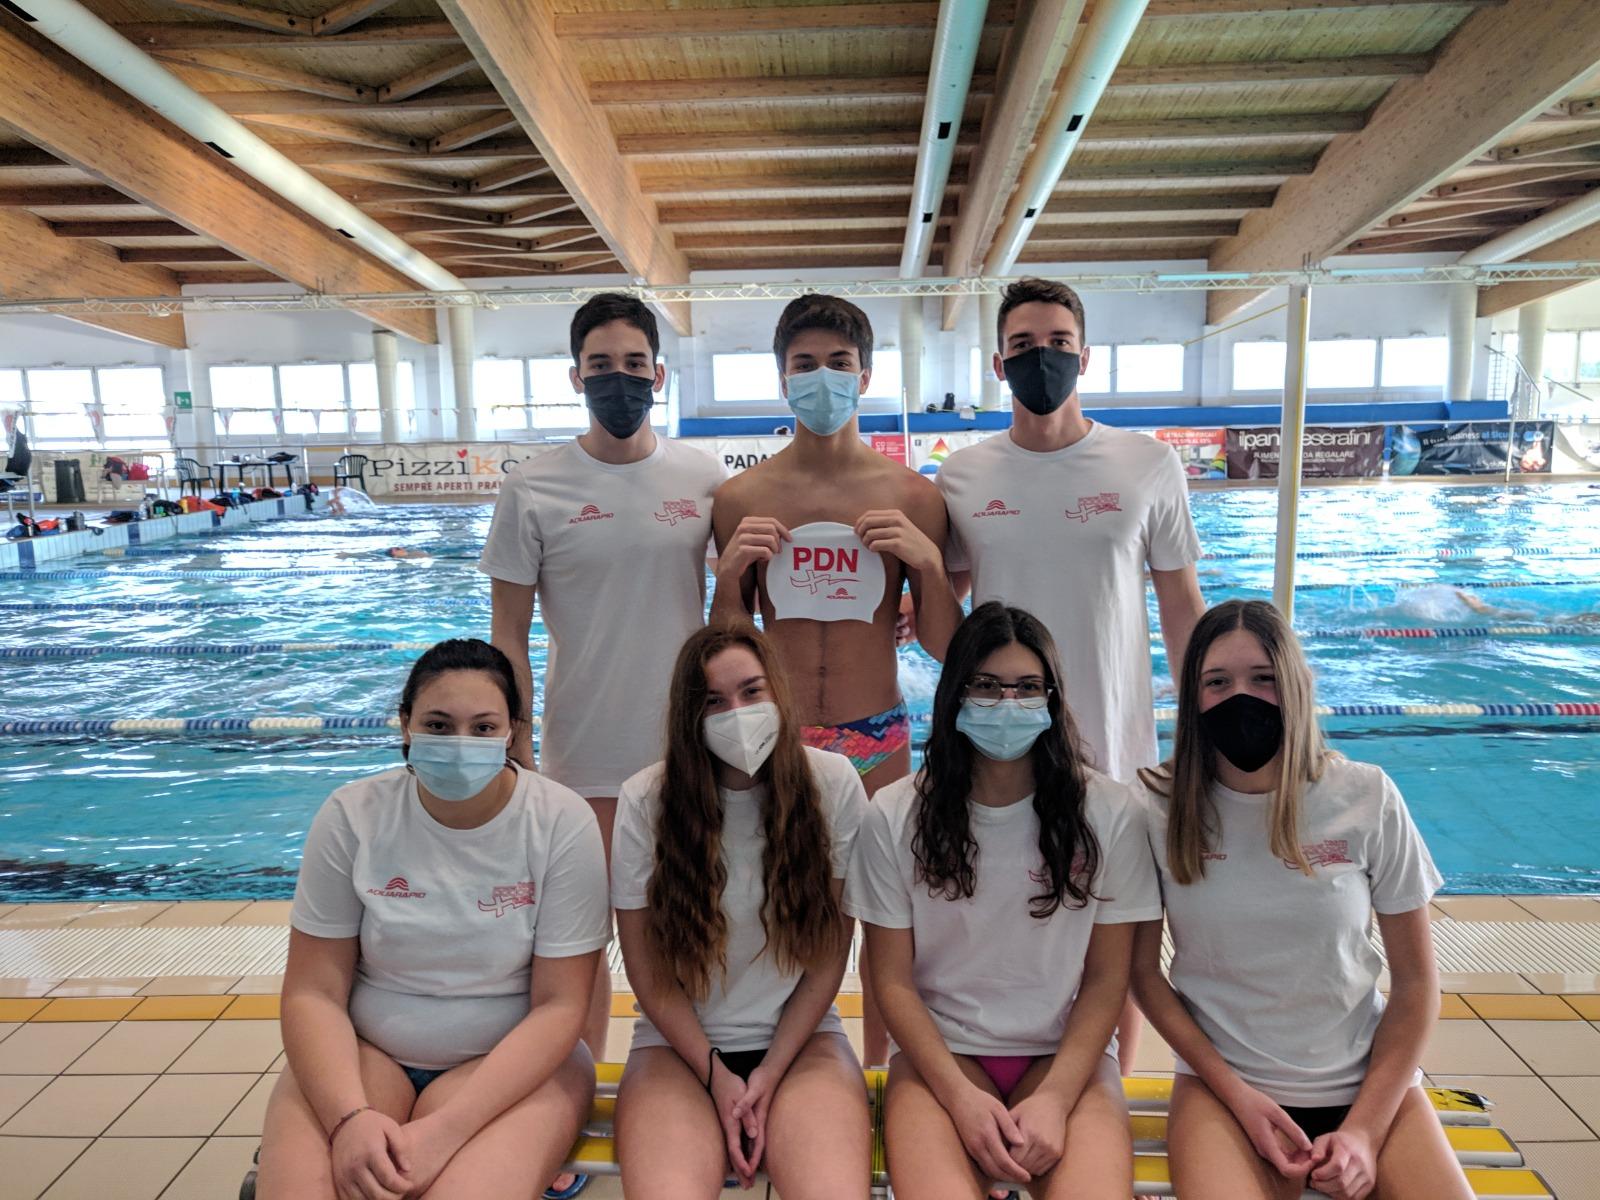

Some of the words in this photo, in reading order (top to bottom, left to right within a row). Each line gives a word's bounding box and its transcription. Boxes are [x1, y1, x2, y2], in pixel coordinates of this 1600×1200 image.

[394, 482, 432, 492] SEMPRE
[436, 481, 473, 491] APERTI
[793, 547, 859, 573] PDN
